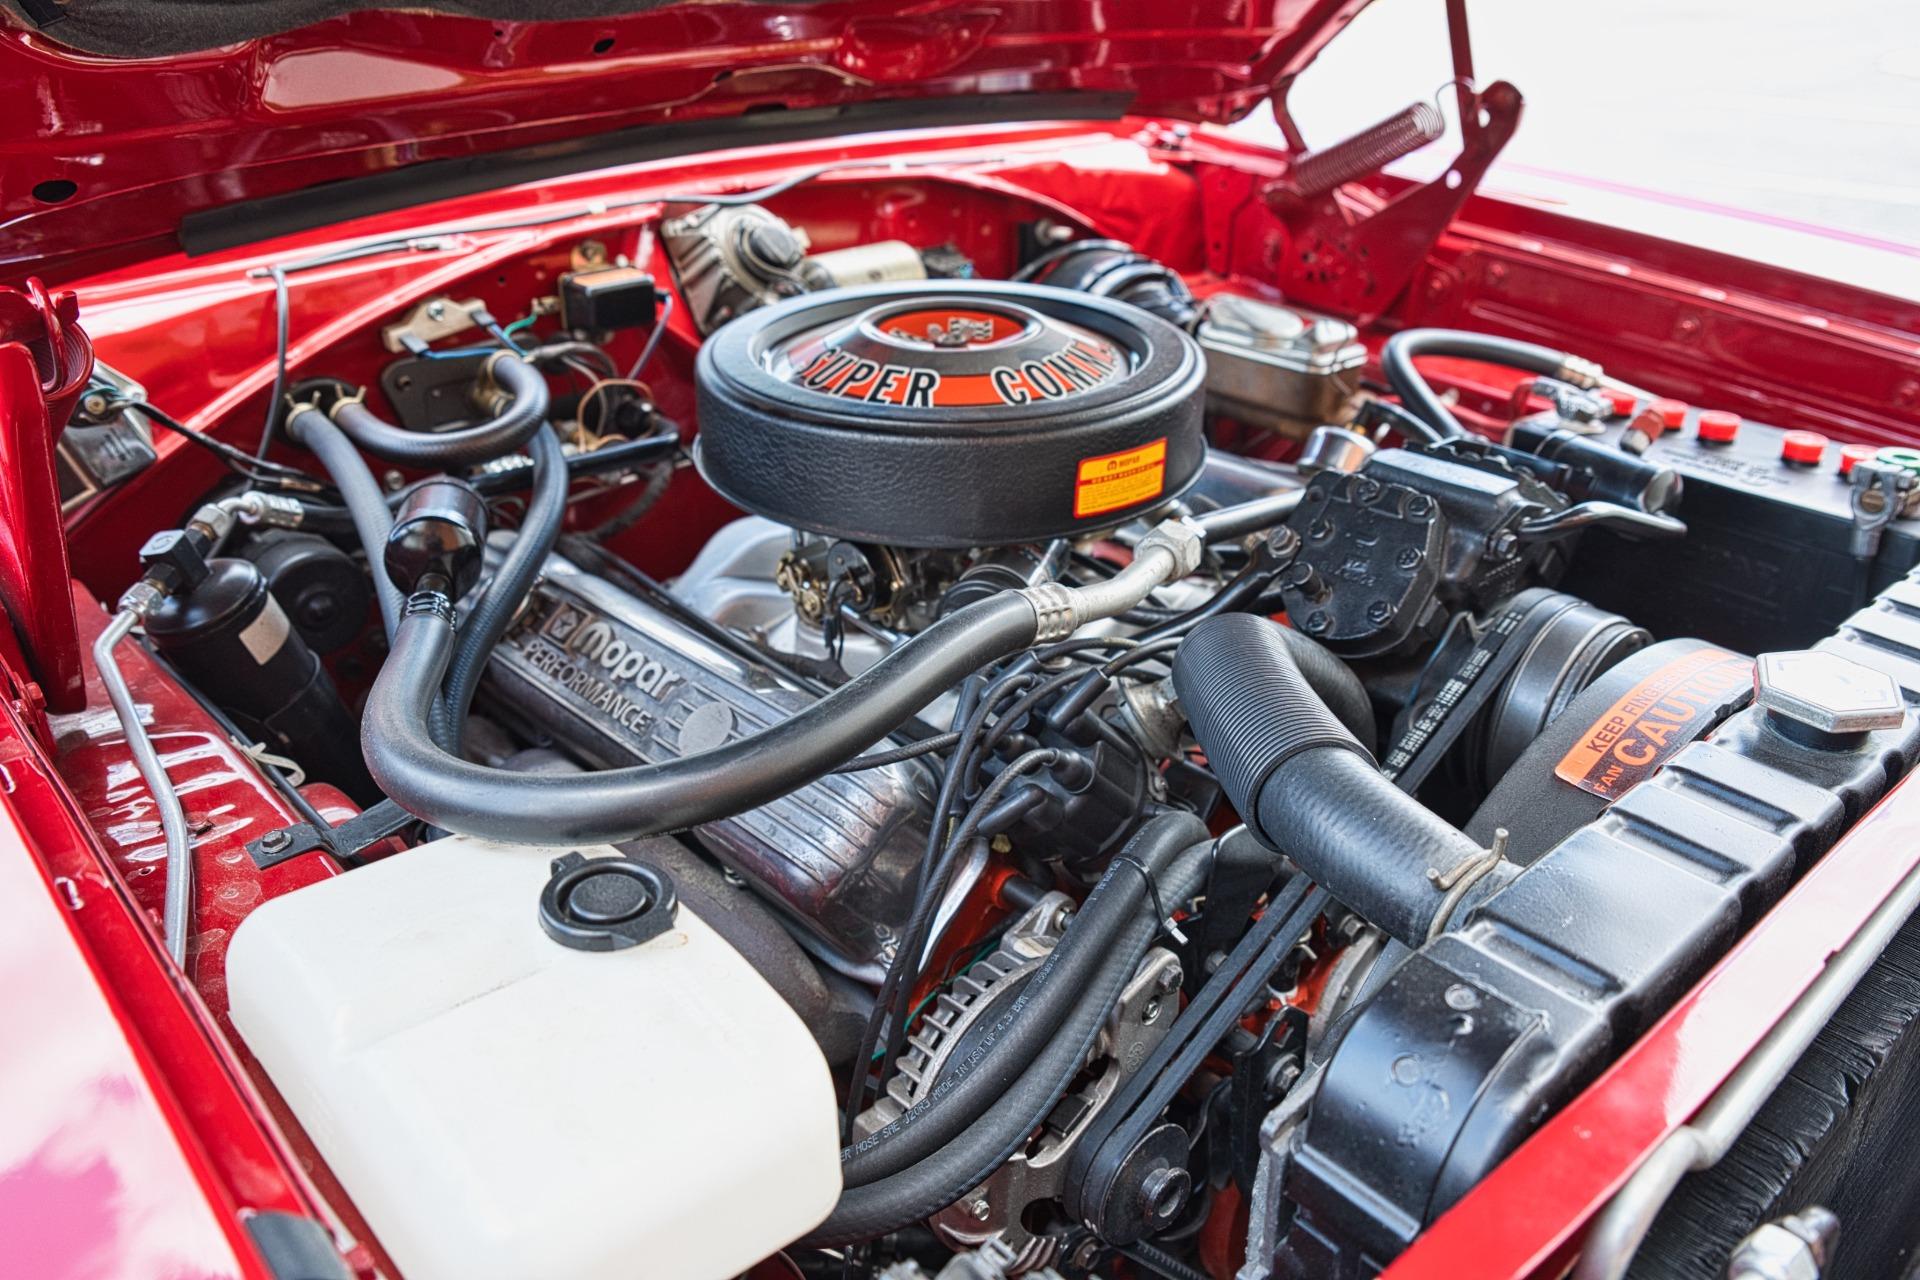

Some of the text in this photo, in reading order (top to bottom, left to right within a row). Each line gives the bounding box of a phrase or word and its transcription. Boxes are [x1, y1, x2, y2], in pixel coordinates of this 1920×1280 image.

[799, 347, 939, 407] SUPER
[521, 639, 653, 735] PERFORMANCE
[1586, 715, 1627, 754] KEEP
[1593, 764, 1624, 793] FAN
[855, 1134, 880, 1156] HOSE
[883, 1121, 901, 1139] SAE
[904, 1096, 931, 1124] J20R3
[932, 1075, 956, 1099] MADE
[955, 1063, 969, 1079] IN
[968, 1046, 984, 1067] USA
[997, 1013, 1014, 1032] 4.3
[1014, 994, 1031, 1013] BAR
